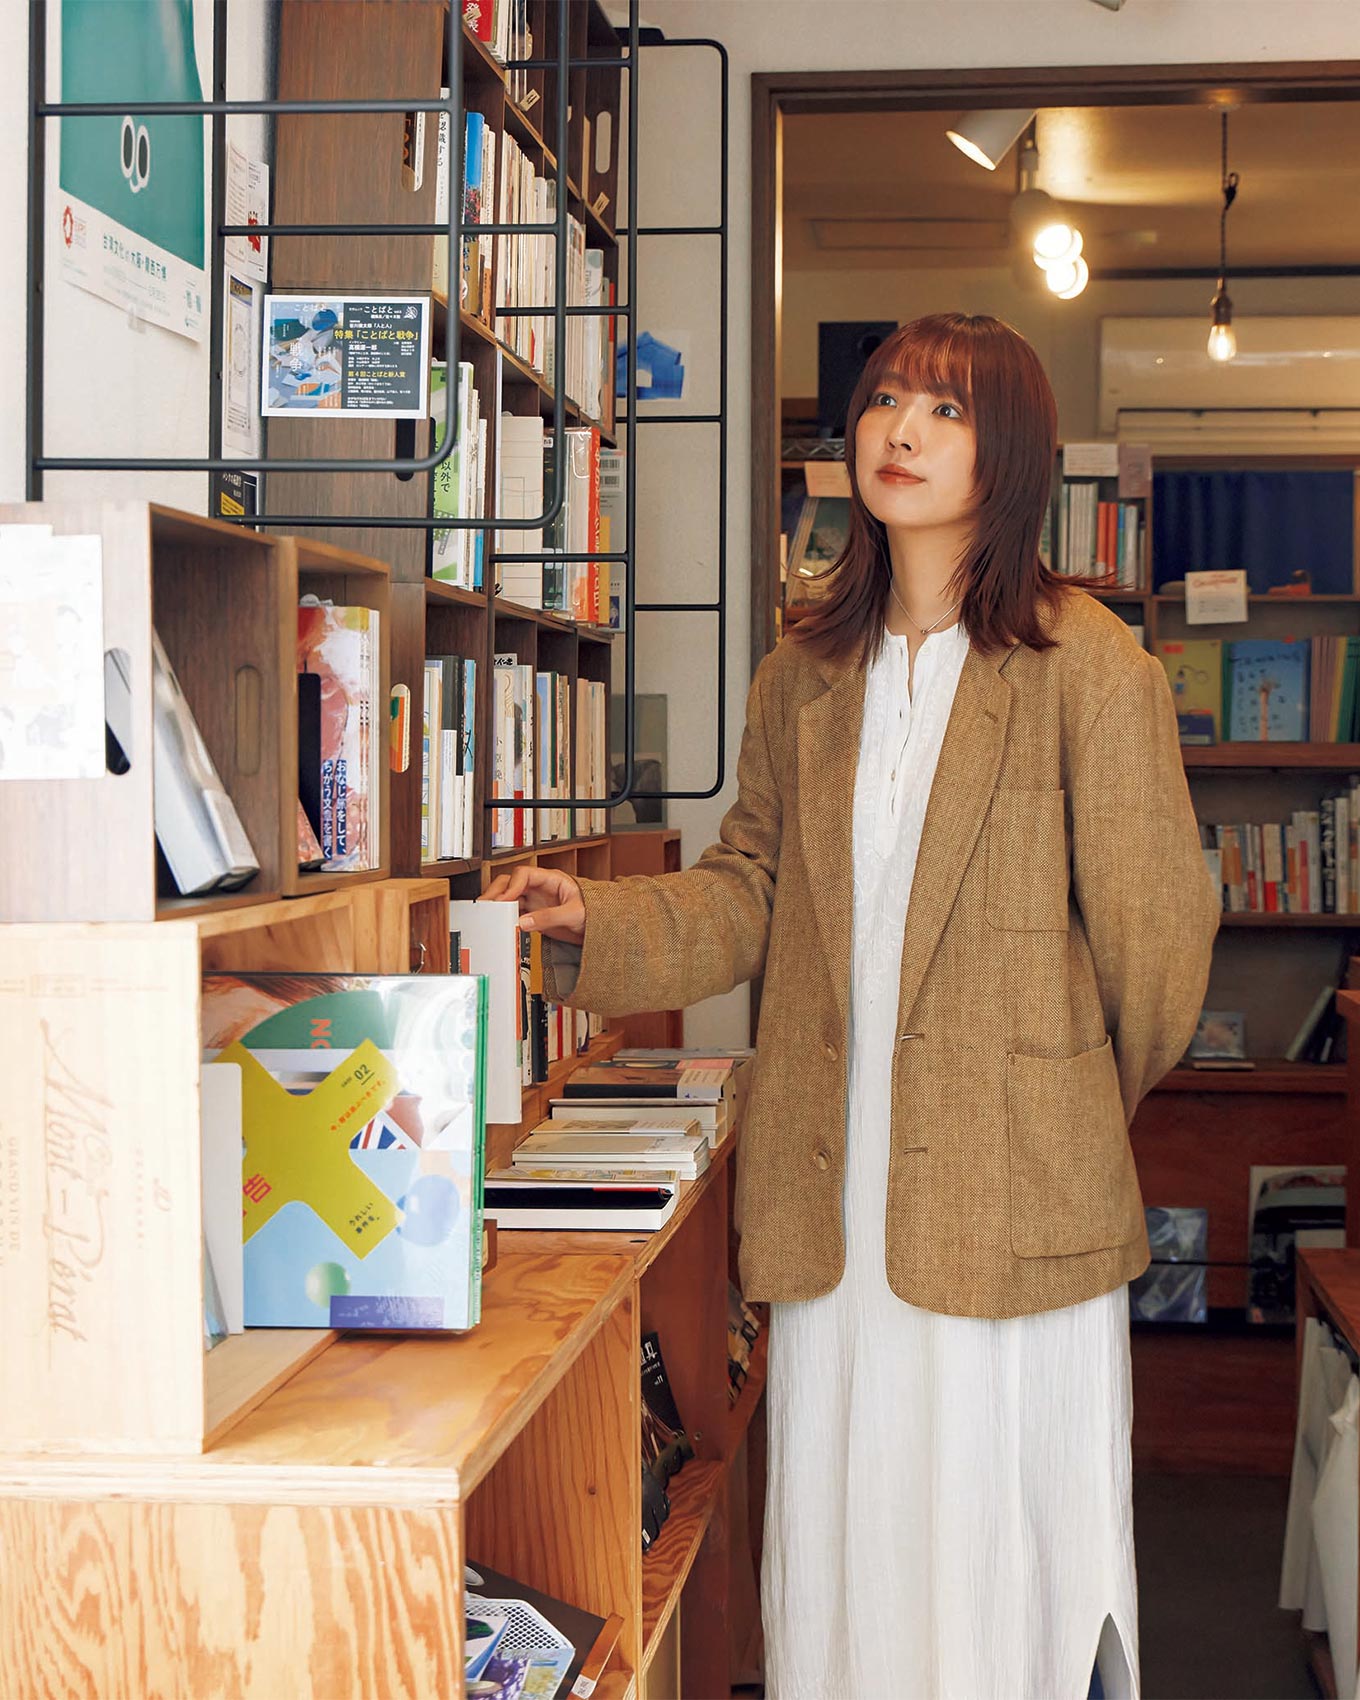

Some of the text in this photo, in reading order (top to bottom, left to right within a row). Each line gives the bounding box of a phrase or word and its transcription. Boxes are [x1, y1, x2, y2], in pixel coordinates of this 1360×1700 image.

[364, 305, 393, 314] ことばと
[334, 329, 419, 341] 特集「ことばと戦争」
[353, 1063, 371, 1081] 02
[7, 1230, 20, 1253] DE
